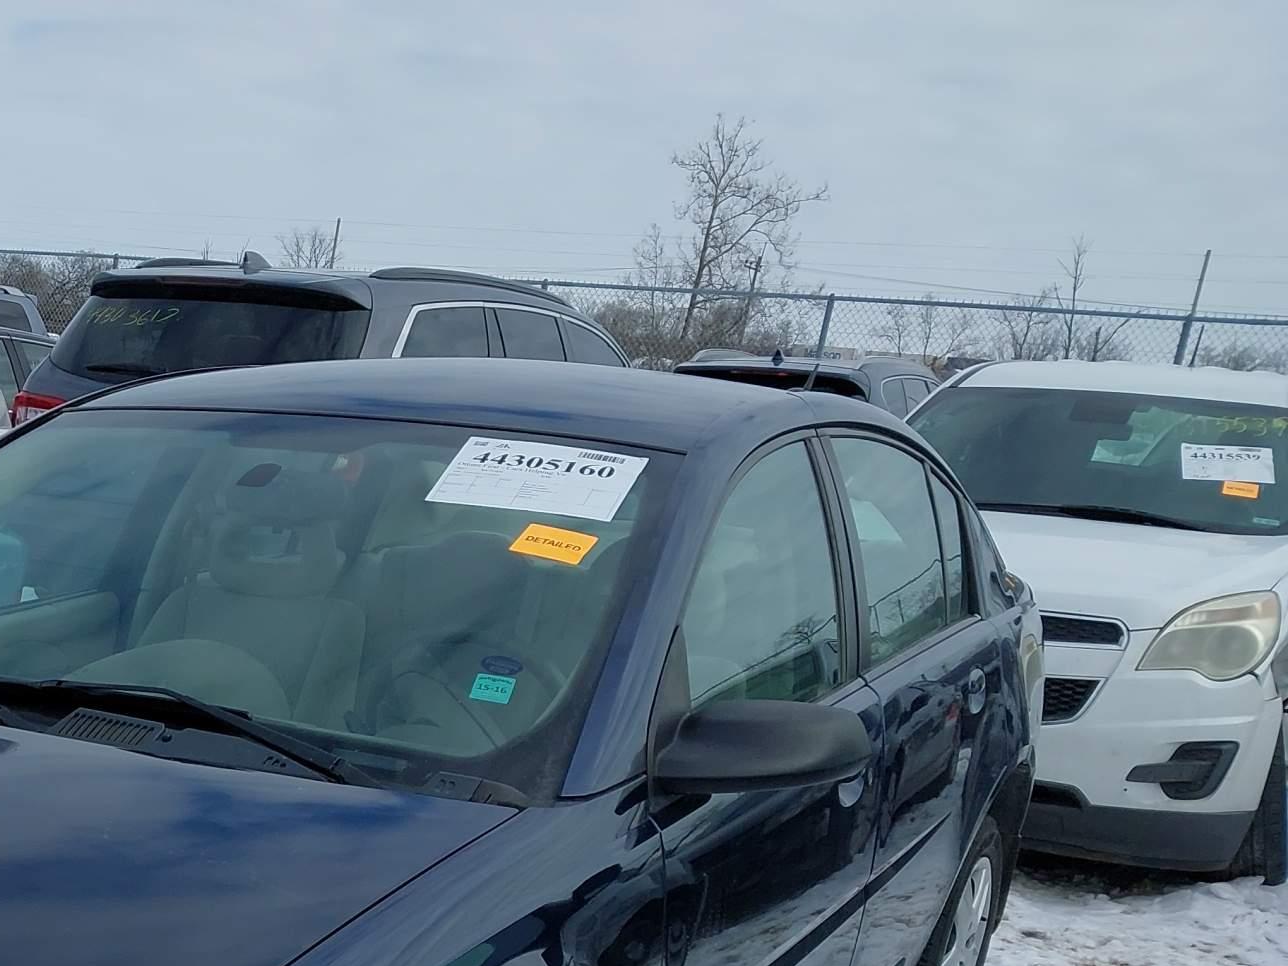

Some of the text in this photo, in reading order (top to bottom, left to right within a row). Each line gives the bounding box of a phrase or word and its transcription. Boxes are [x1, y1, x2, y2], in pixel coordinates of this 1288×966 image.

[472, 451, 616, 478] 44305160
[525, 535, 582, 552] DETAILED
[477, 683, 507, 694] 15-16
